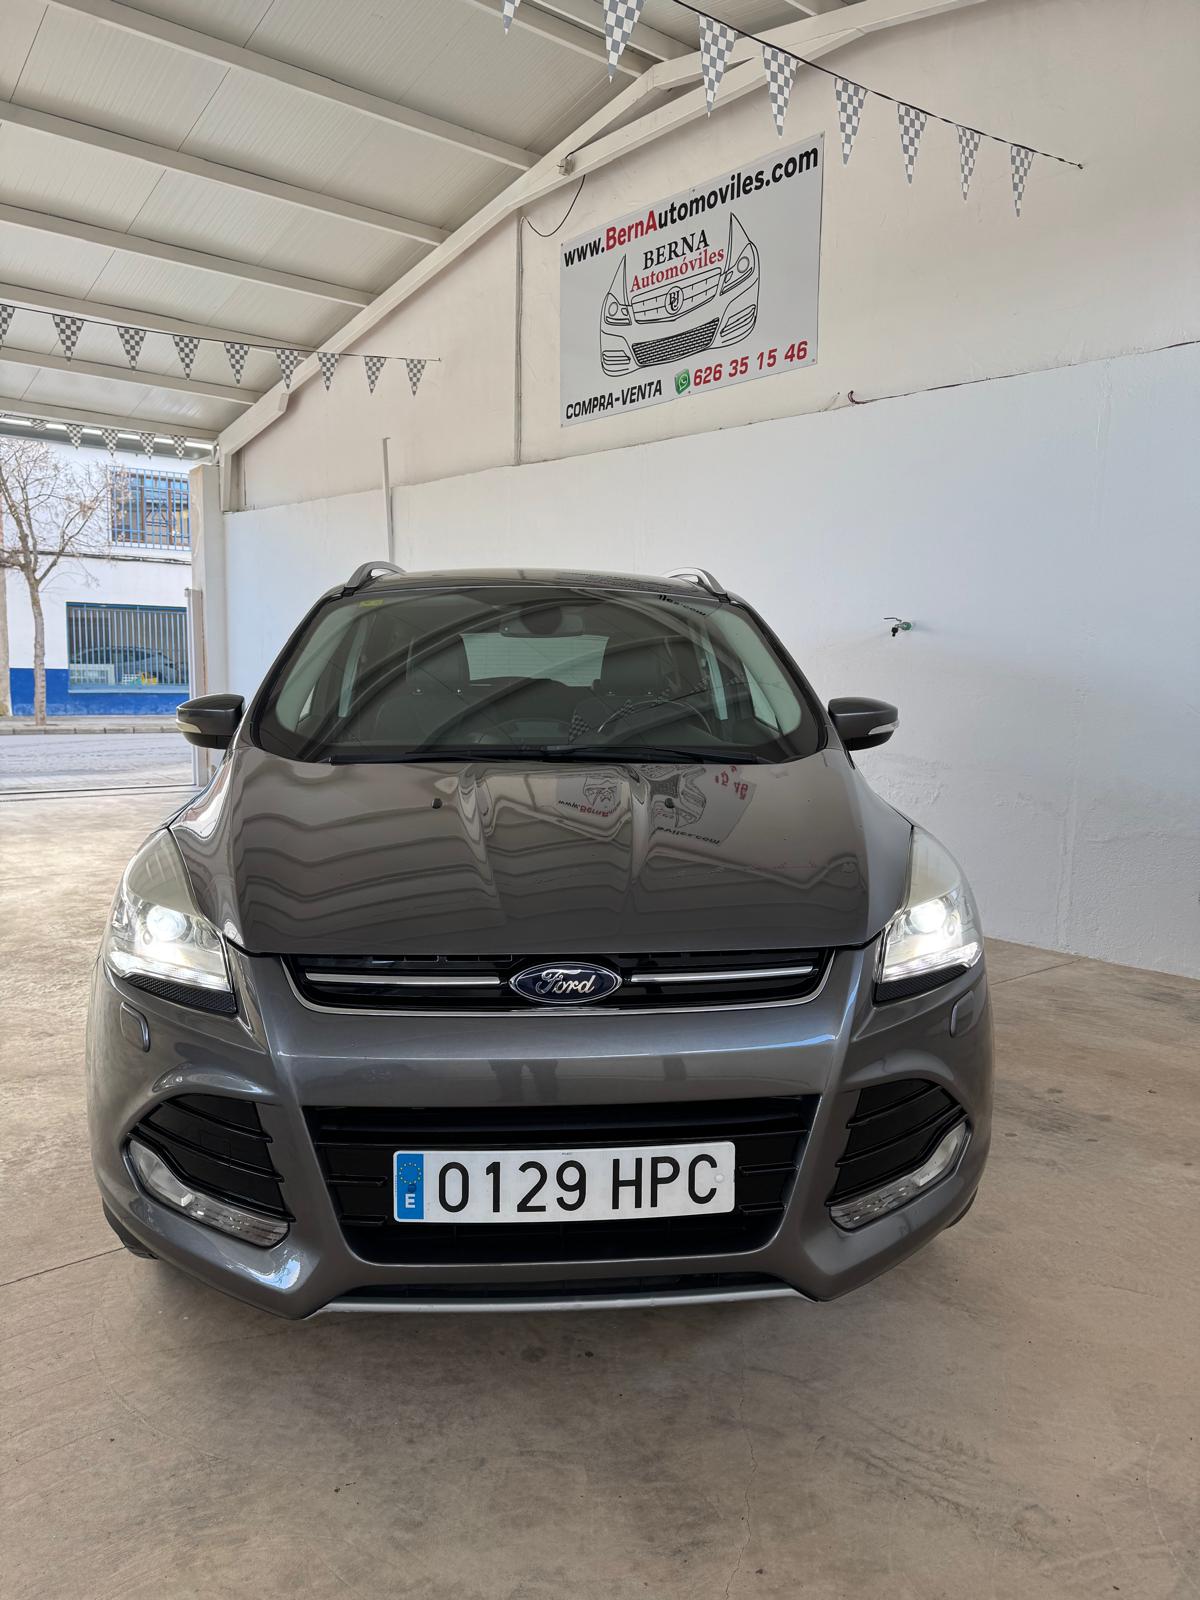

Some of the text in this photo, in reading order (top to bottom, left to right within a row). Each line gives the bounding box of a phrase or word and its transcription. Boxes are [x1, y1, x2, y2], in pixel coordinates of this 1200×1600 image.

[564, 147, 819, 267] www.BernAutomoviles.com
[630, 248, 725, 292] Automóviles
[643, 229, 710, 270] BERNA
[693, 340, 808, 386] 626 35 15 46
[565, 379, 663, 420] COMPRA-VENTA
[535, 968, 597, 994] Ford
[404, 1193, 416, 1209] E
[438, 1153, 718, 1213] 0129 HPC
